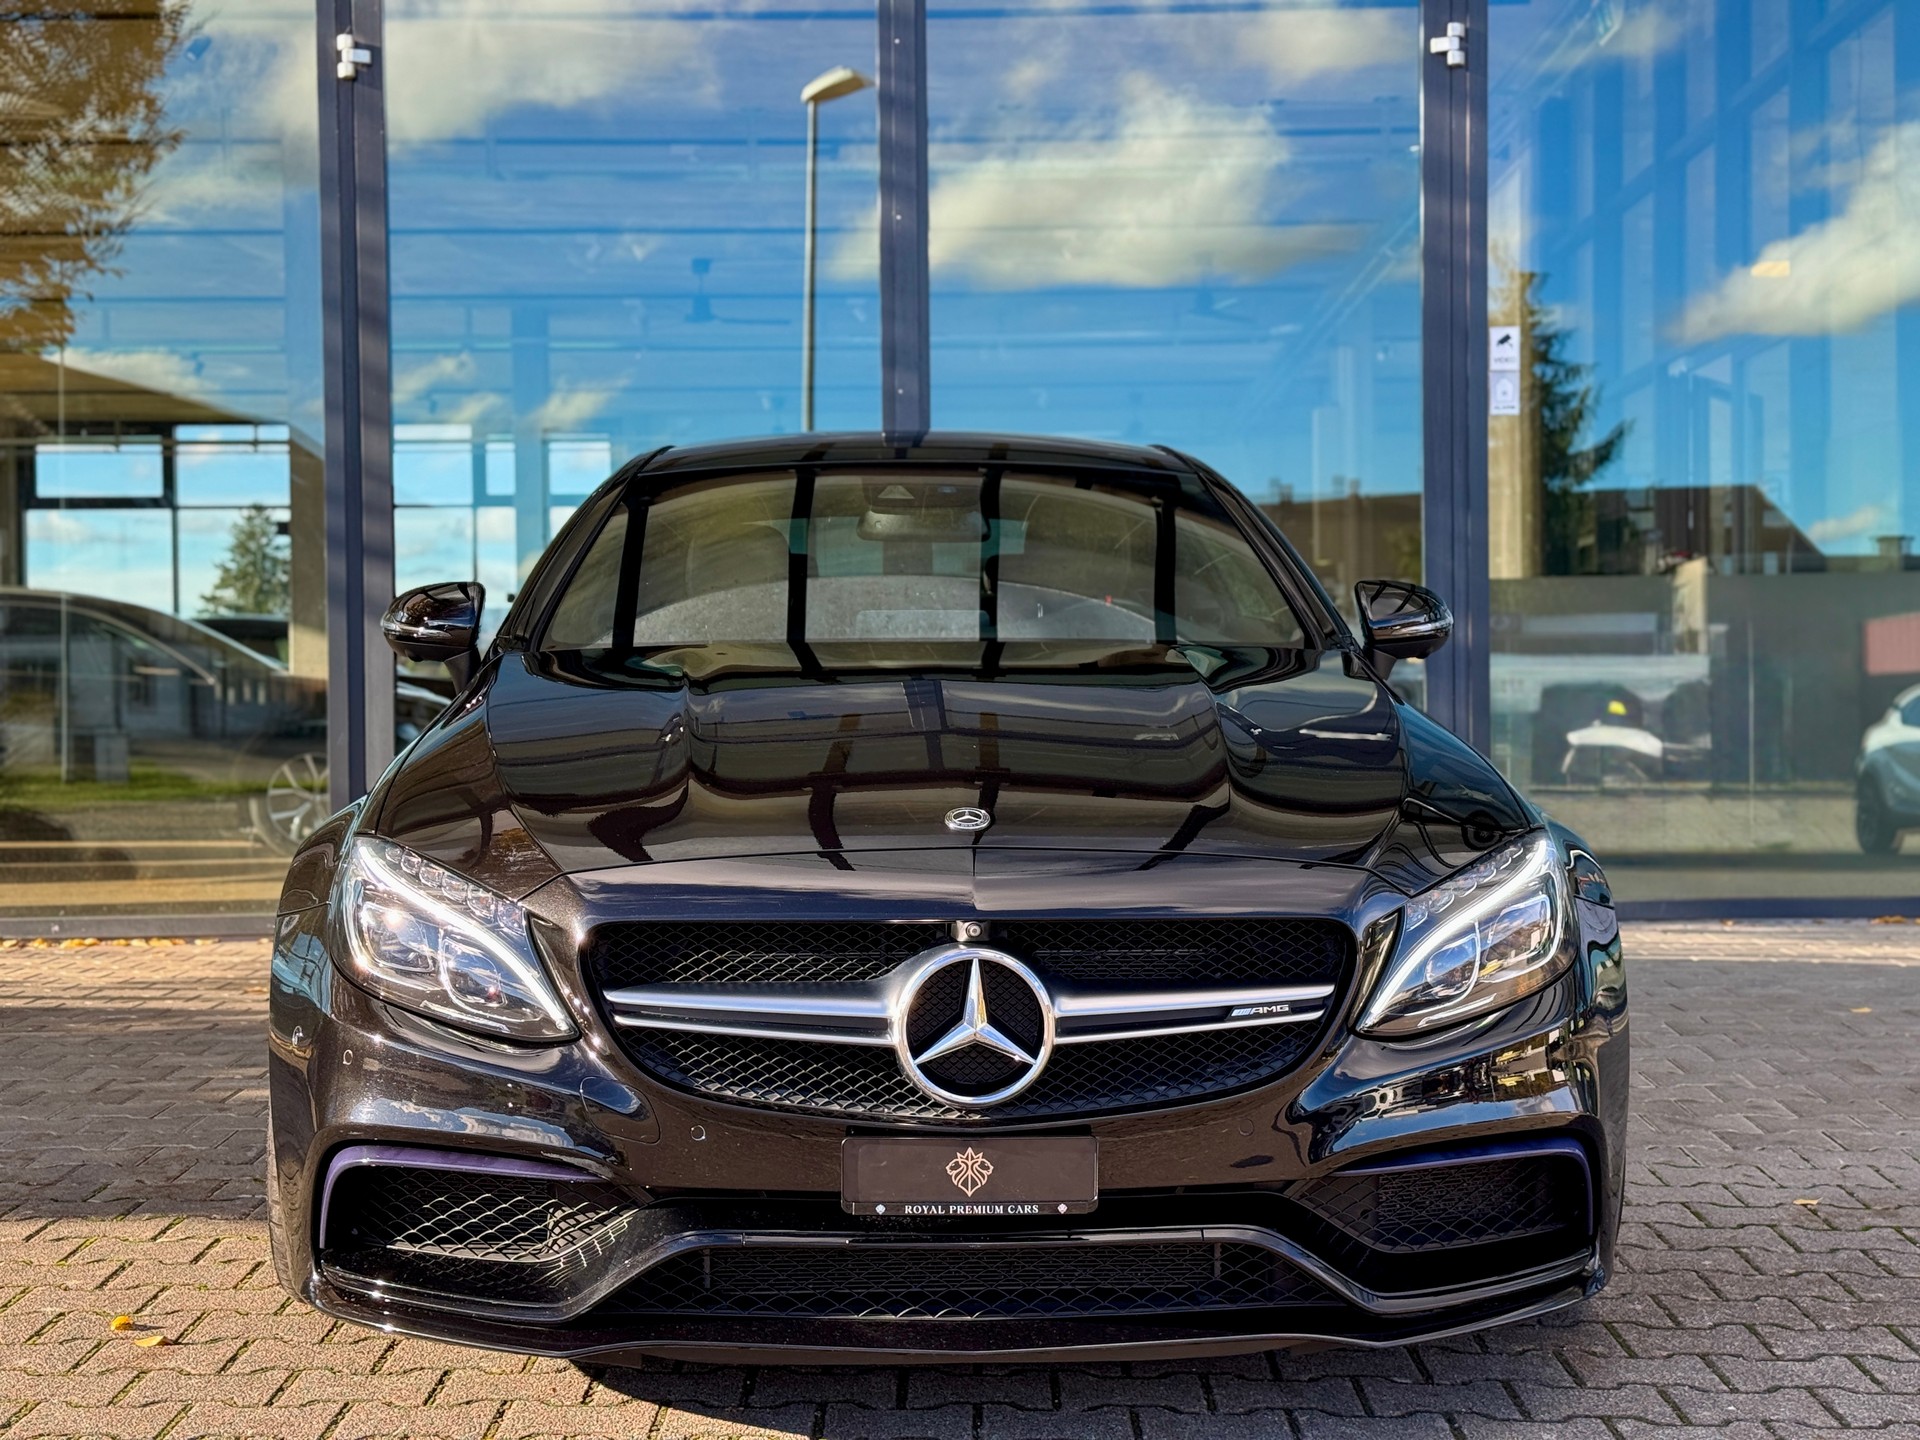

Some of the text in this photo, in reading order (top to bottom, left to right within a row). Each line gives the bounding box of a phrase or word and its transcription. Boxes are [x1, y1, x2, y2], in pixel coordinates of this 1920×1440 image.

[1250, 1005, 1289, 1014] AMG
[904, 1204, 1039, 1214] ROYAL PREMIUM CARS
